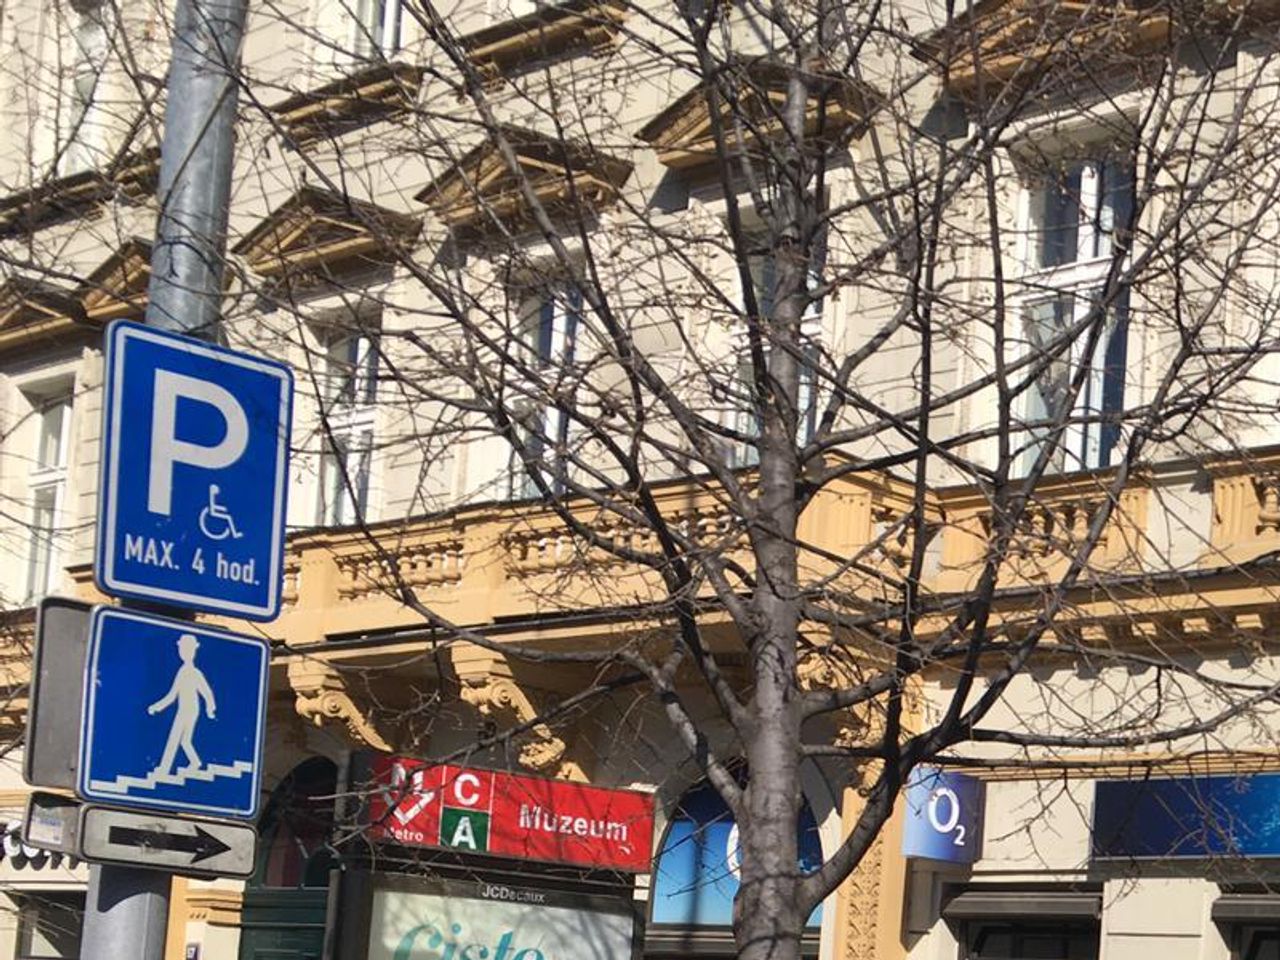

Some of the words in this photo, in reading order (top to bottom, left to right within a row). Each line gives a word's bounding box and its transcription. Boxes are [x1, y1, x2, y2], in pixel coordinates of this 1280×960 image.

[148, 367, 249, 516] P
[124, 533, 180, 571] MAX.
[192, 548, 206, 575] 4
[216, 551, 261, 586] hod.
[453, 772, 481, 806] C
[450, 816, 487, 850] A
[518, 804, 628, 842] Muzeum
